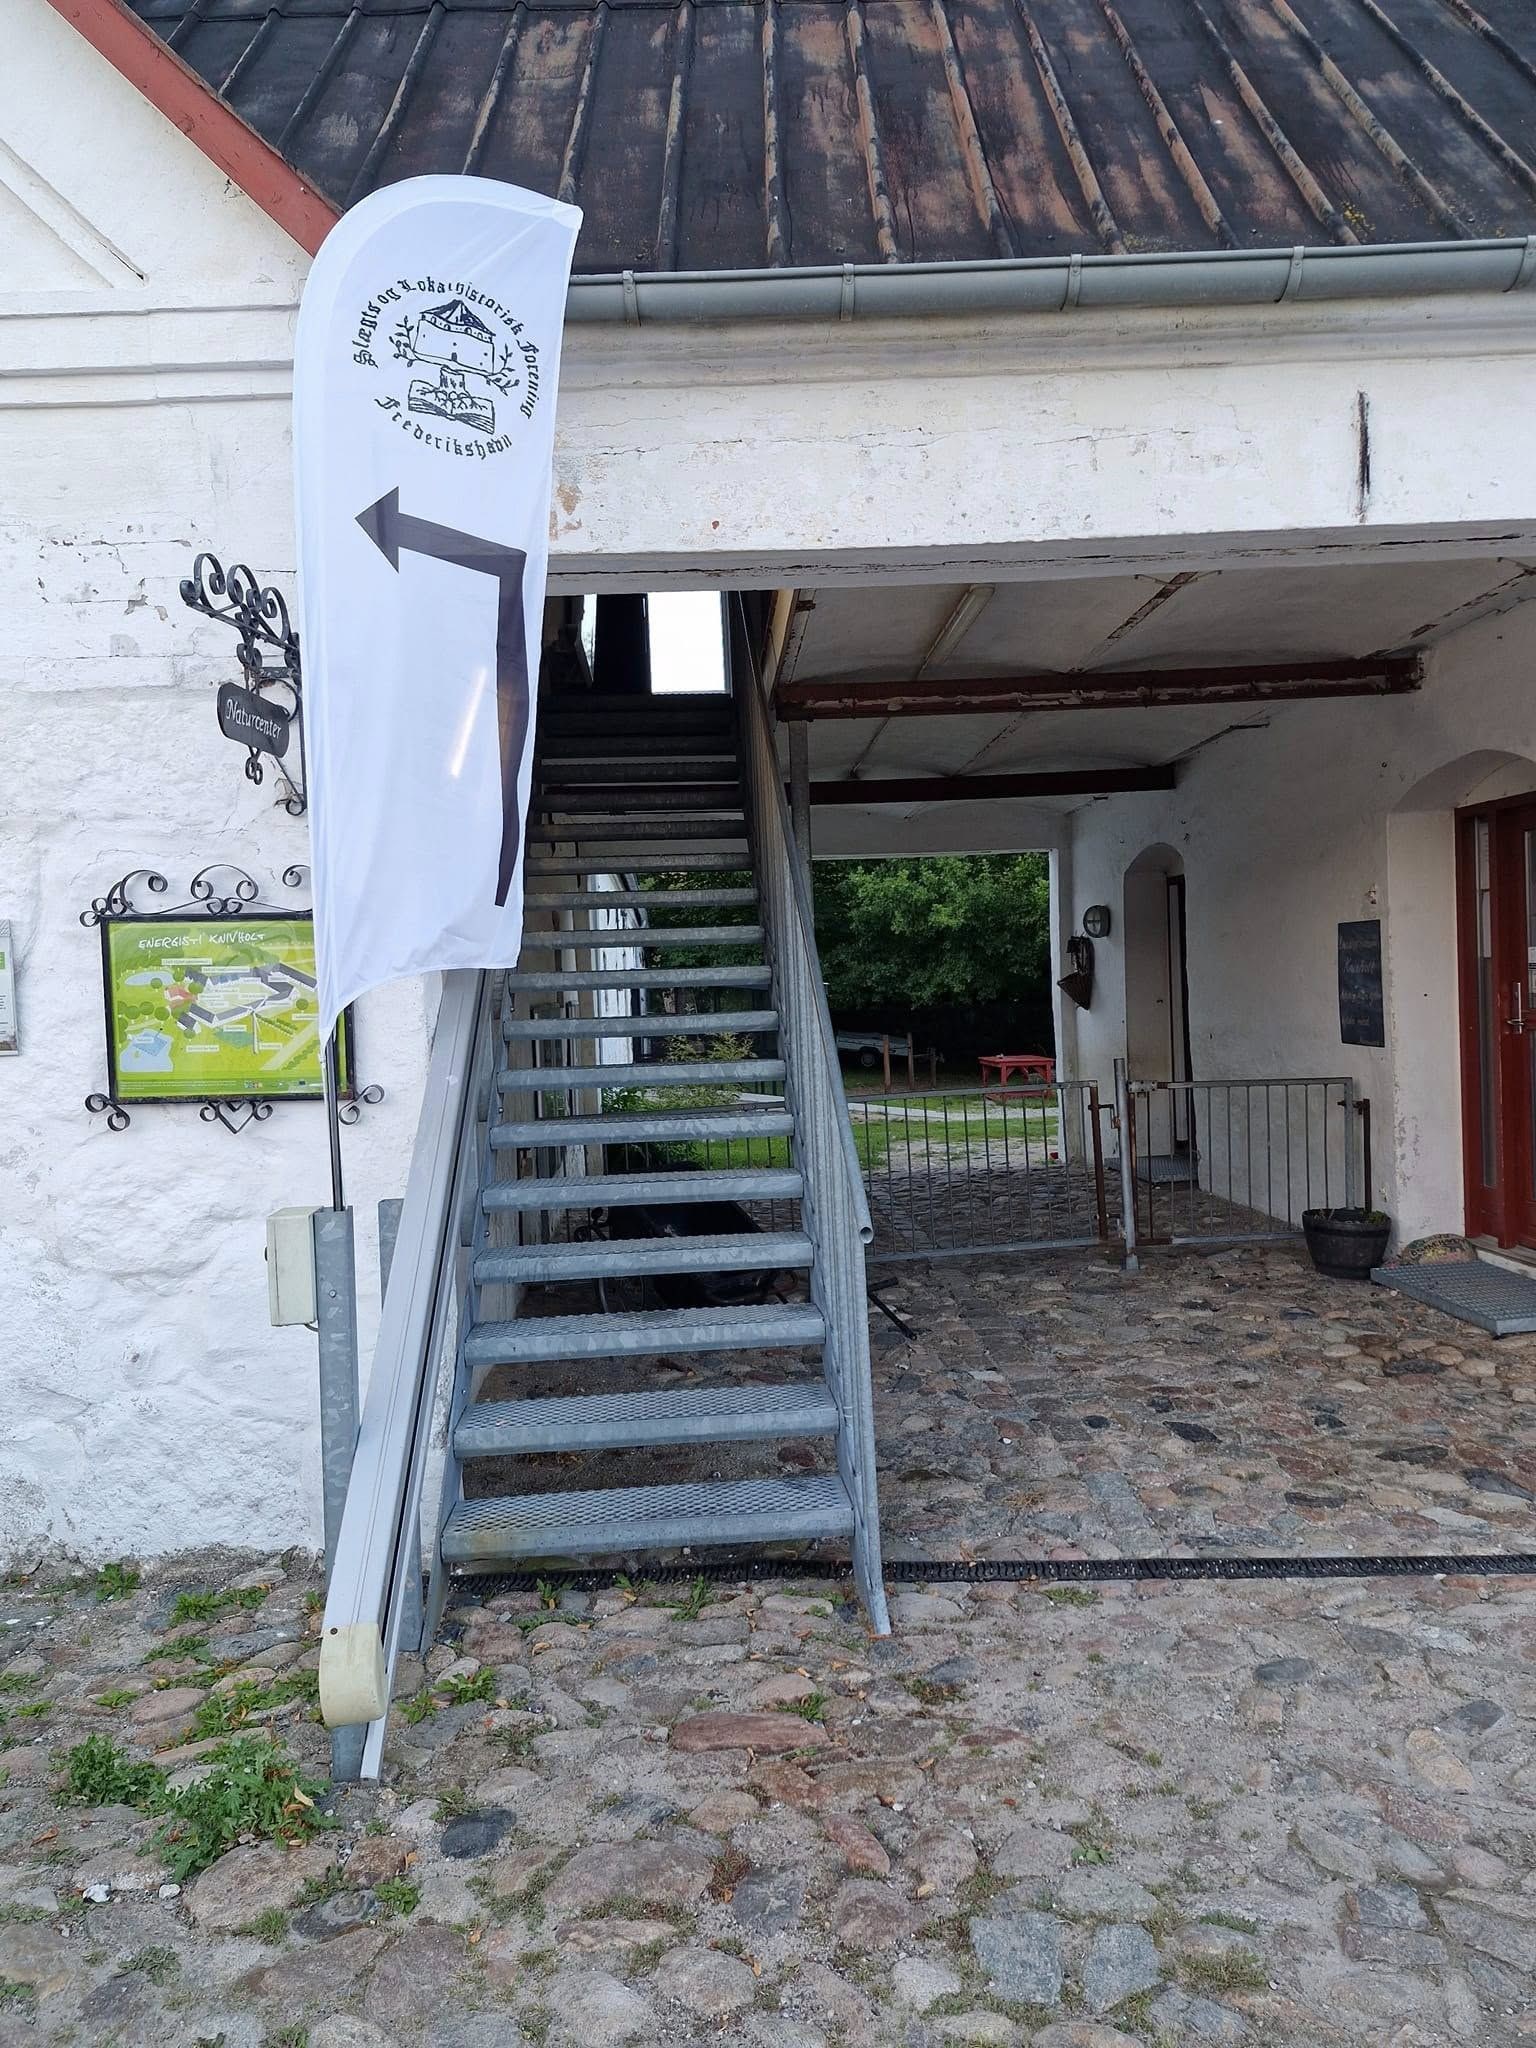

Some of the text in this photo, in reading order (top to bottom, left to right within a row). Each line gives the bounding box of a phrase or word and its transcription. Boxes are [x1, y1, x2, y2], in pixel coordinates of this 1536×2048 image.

[377, 287, 402, 304] og
[374, 396, 513, 460] Frederikshavn
[225, 698, 282, 739] Naturcenter
[208, 930, 267, 944] KNIVHOLT
